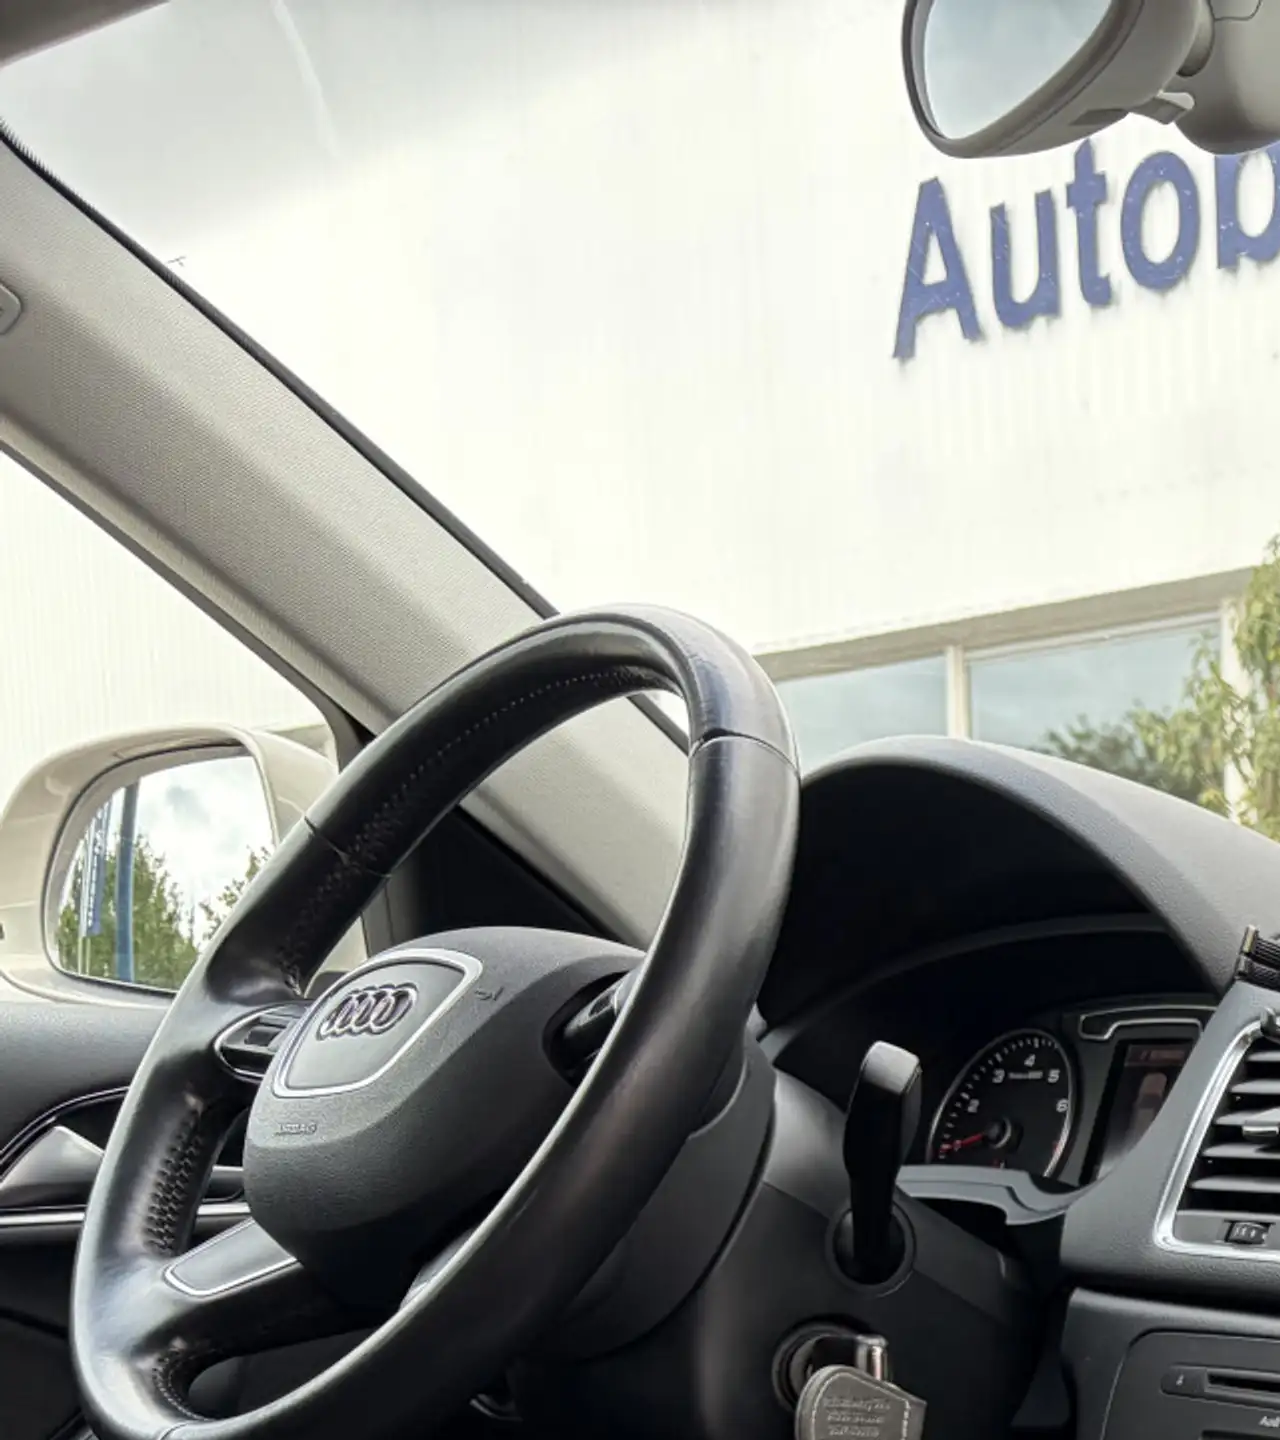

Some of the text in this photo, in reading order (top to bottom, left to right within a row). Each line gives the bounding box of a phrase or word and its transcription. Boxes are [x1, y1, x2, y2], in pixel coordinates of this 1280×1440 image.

[1024, 1053, 1036, 1067] 4
[992, 1069, 1006, 1084] 3
[1047, 1069, 1060, 1083] 5
[1056, 1098, 1069, 1113] 6
